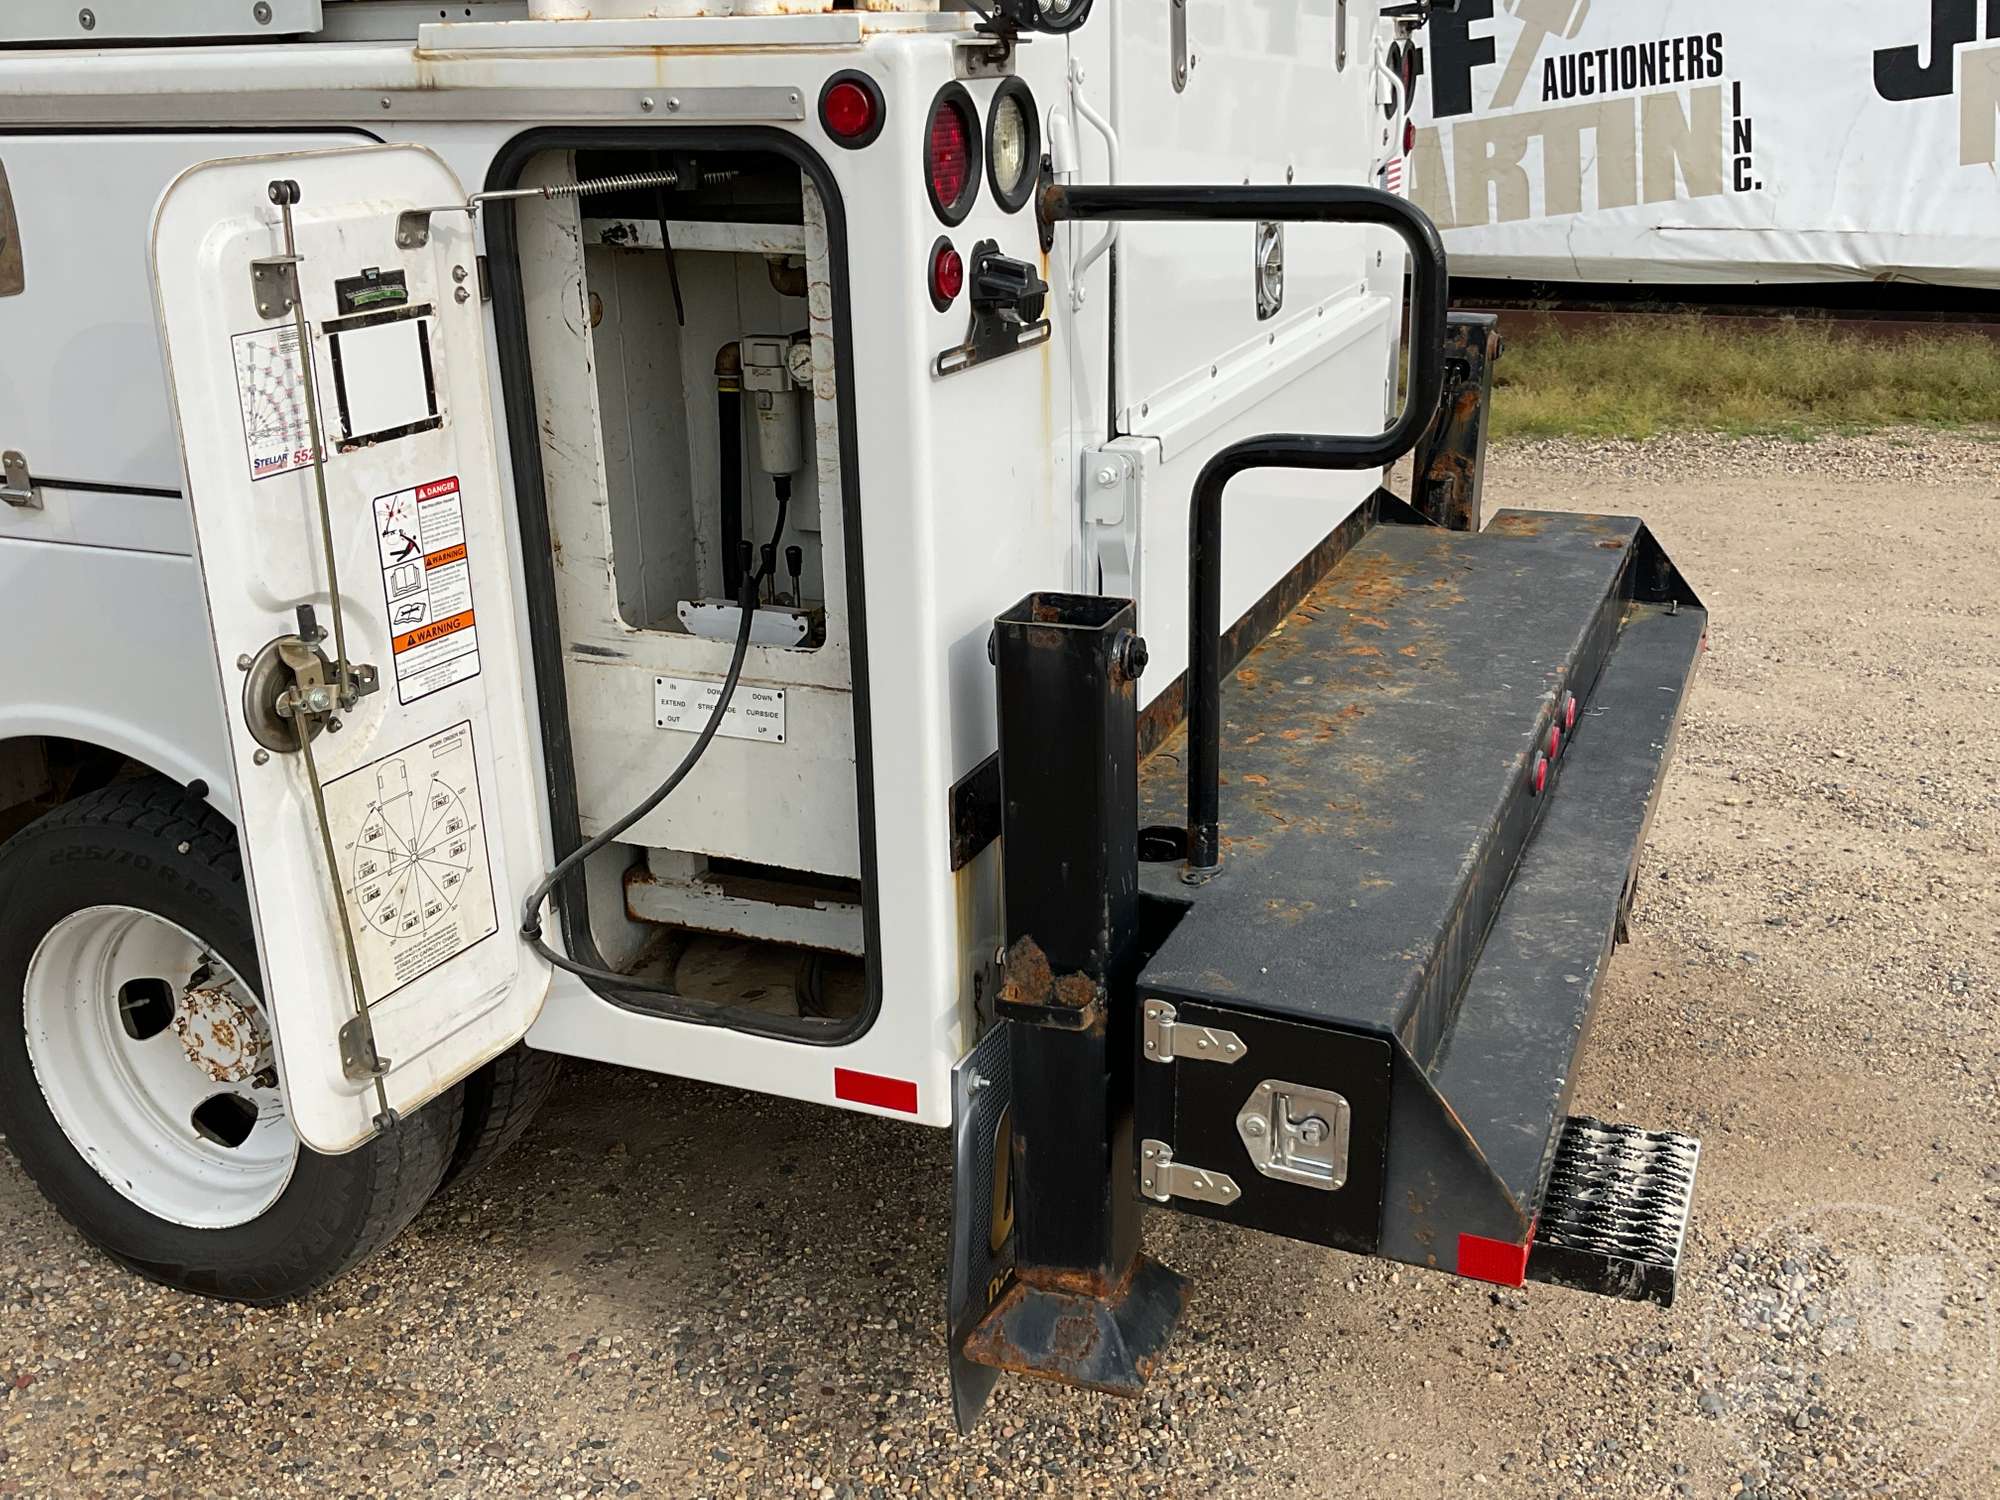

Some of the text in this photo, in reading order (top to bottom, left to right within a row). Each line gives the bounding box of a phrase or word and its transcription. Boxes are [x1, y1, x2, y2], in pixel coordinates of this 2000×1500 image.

[1542, 33, 1723, 102] AUCTIONEERS
[1732, 81, 1763, 192] INC.
[1408, 86, 1723, 231] ARTIN
[254, 446, 323, 468] STELLAR 552
[427, 481, 455, 496] DANGER
[432, 548, 464, 563] WARNING
[417, 619, 461, 641] WARNING
[661, 699, 686, 707] EXTEND
[746, 709, 779, 718] CURBSIDE
[752, 693, 773, 702] DOWN
[420, 941, 441, 957] CAPACITY
[442, 932, 458, 943] CHART
